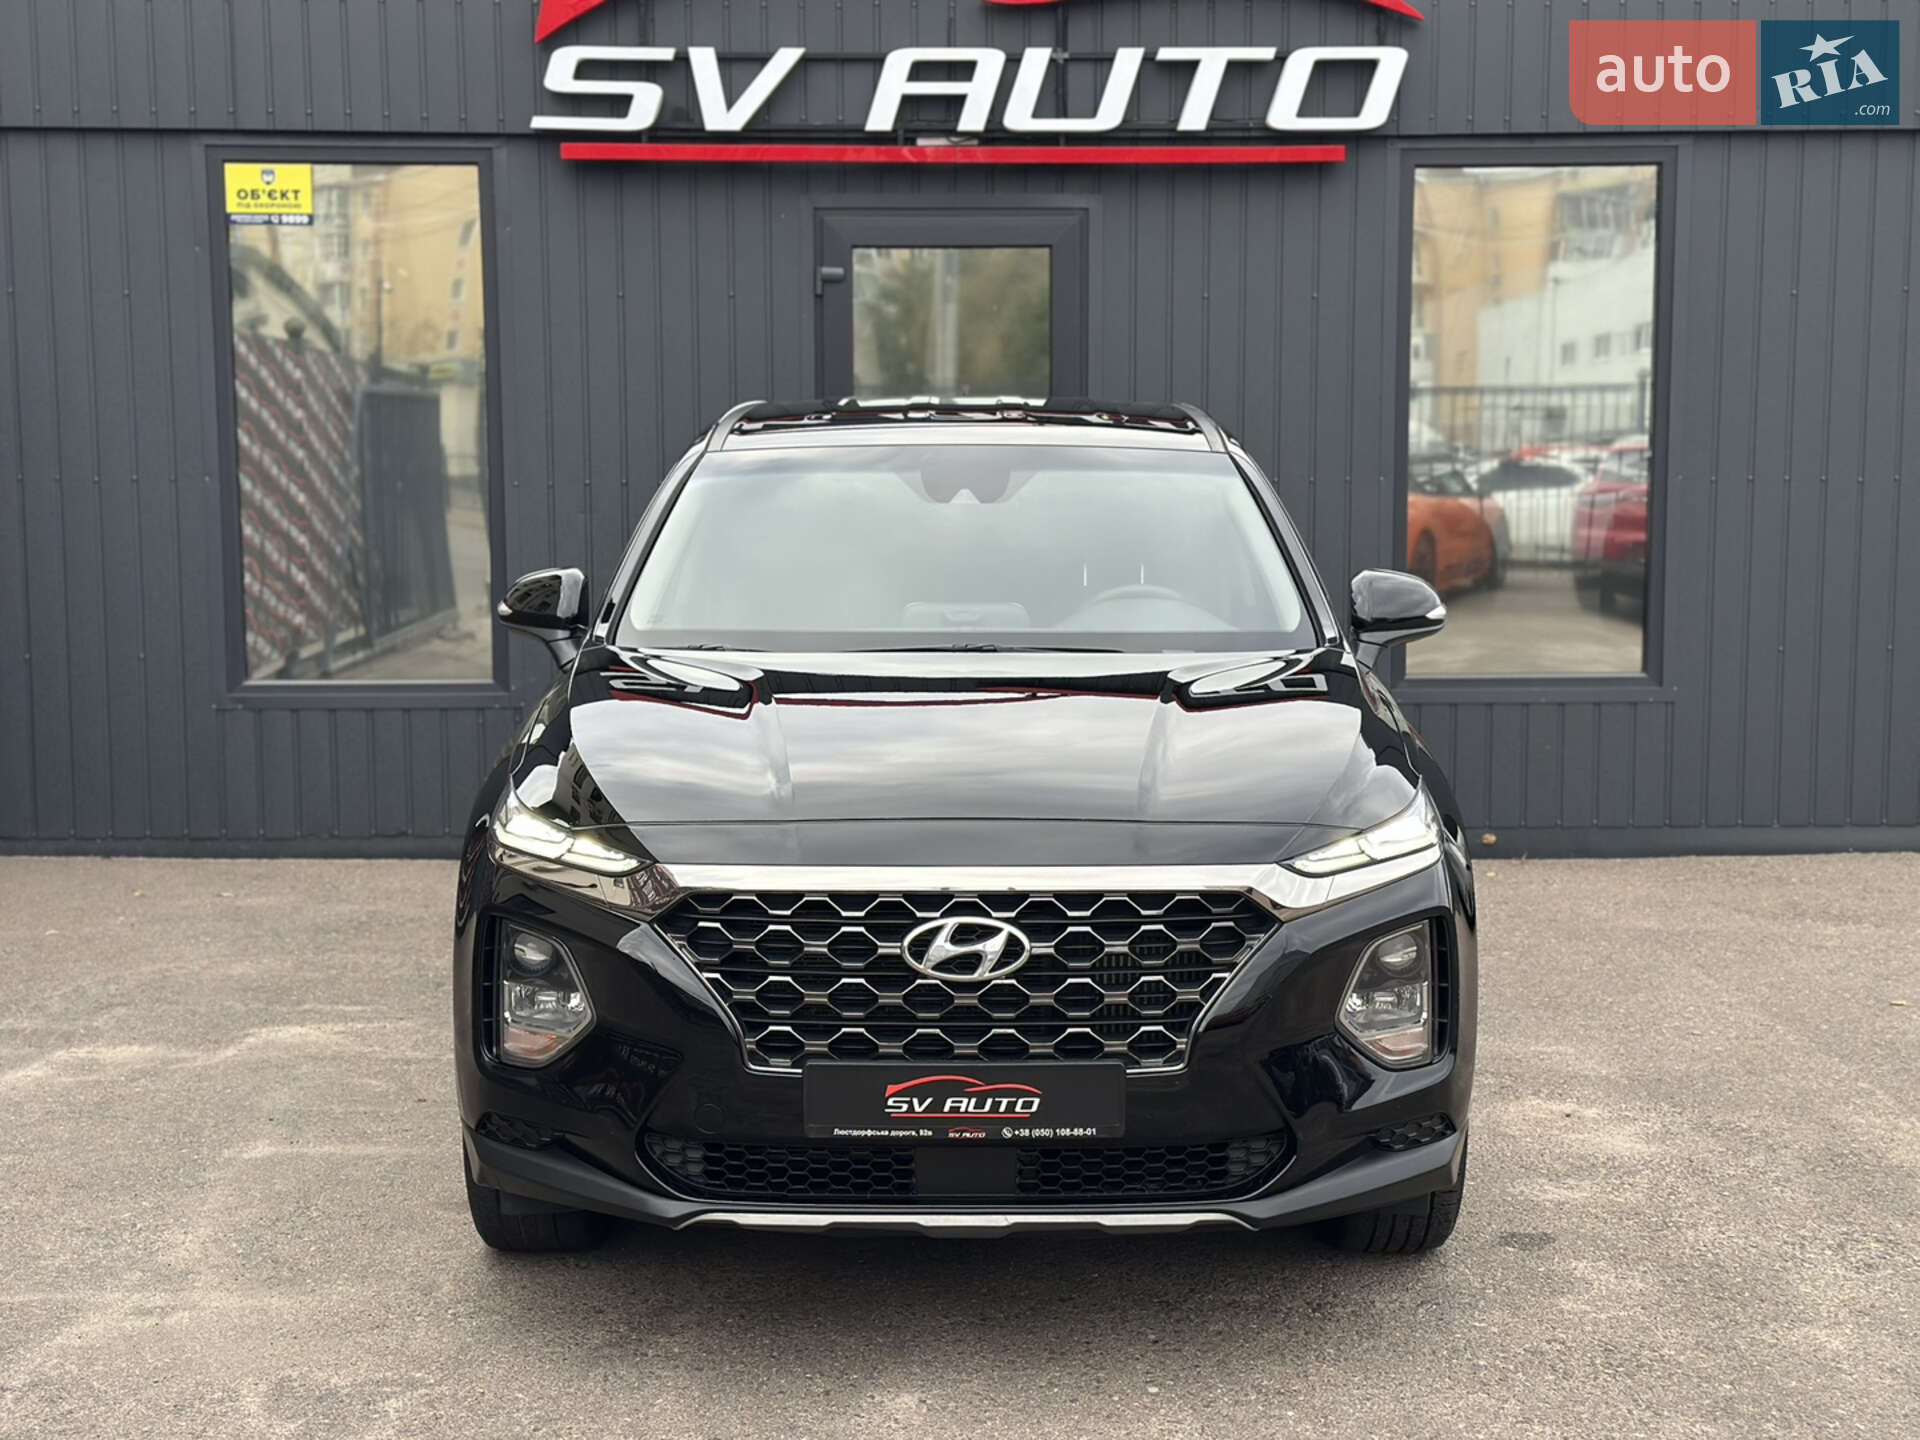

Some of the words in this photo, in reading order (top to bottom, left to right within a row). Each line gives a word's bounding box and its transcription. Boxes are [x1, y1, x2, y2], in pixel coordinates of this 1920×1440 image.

[529, 45, 806, 132] SV
[864, 46, 1409, 133] AUTO
[884, 1097, 934, 1113] SV
[943, 1097, 1041, 1113] AUTO
